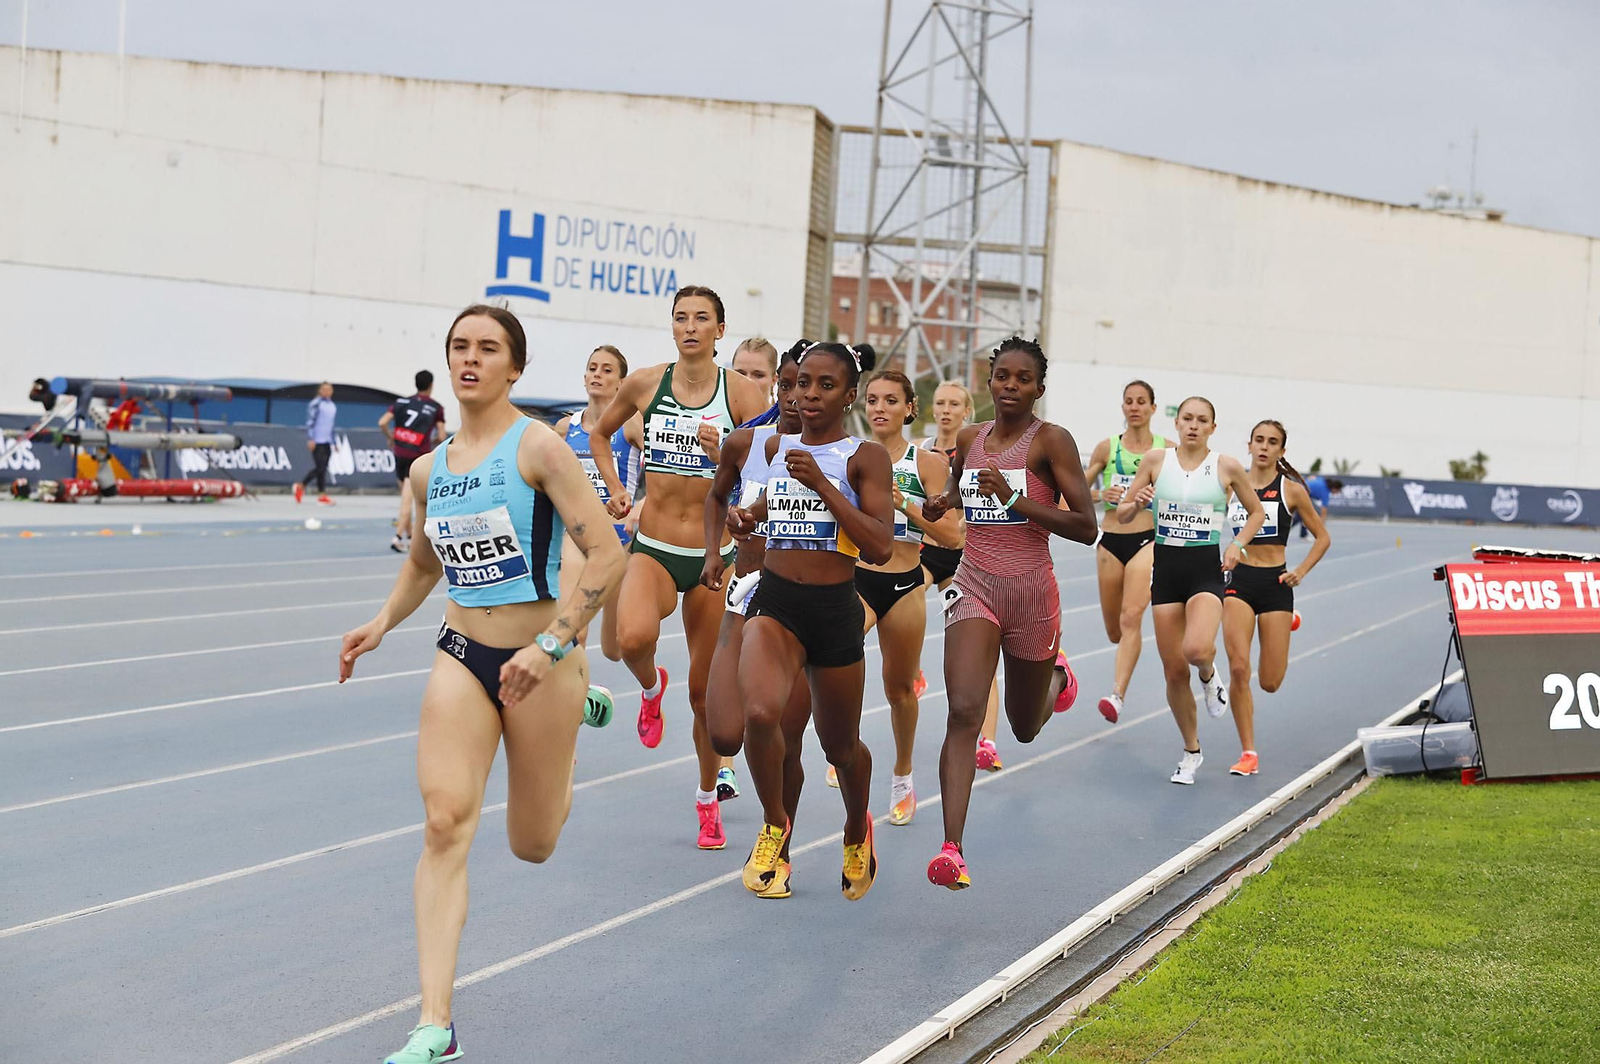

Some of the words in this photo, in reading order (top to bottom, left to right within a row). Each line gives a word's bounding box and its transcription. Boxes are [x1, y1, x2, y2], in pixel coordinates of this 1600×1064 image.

[556, 215, 696, 260] DIPUTACIÓN
[554, 256, 582, 289] DE
[590, 261, 678, 298] HUELVA
[404, 409, 418, 427] 7
[676, 445, 693, 453] 102
[768, 499, 829, 512] LMANZ
[788, 512, 806, 520] 100
[1158, 511, 1210, 525] HARTIGAN
[434, 534, 518, 564] PACER
[1451, 572, 1560, 611] Discus
[1542, 672, 1600, 730] 20
